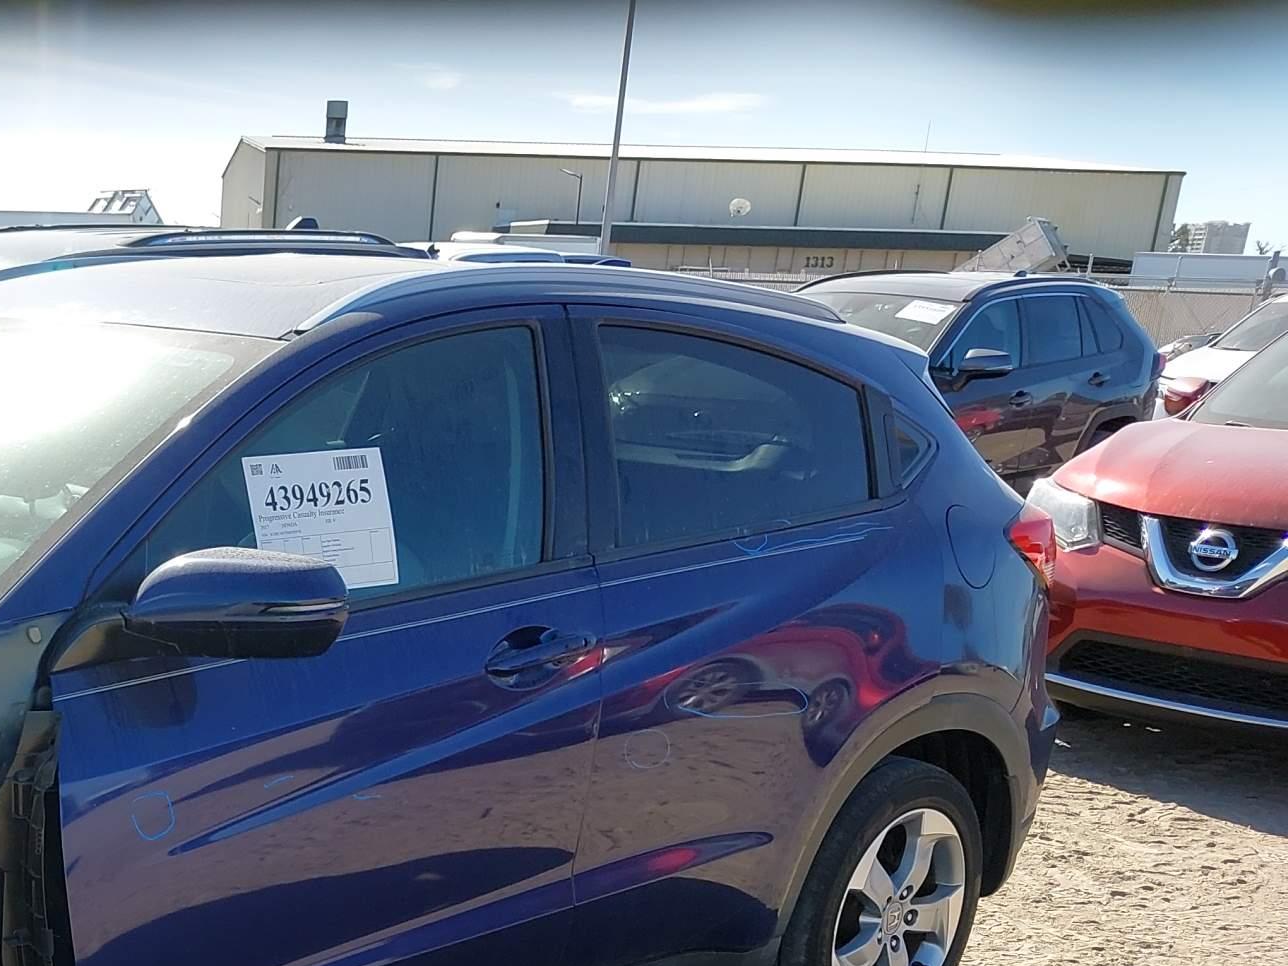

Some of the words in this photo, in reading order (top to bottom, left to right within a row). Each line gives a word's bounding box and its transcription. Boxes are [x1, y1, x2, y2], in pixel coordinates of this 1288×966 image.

[804, 256, 834, 268] 1313
[265, 478, 372, 511] 43949265
[258, 513, 292, 523] Progressive
[293, 511, 317, 520] Casualty
[1193, 546, 1233, 556] NISSAN
